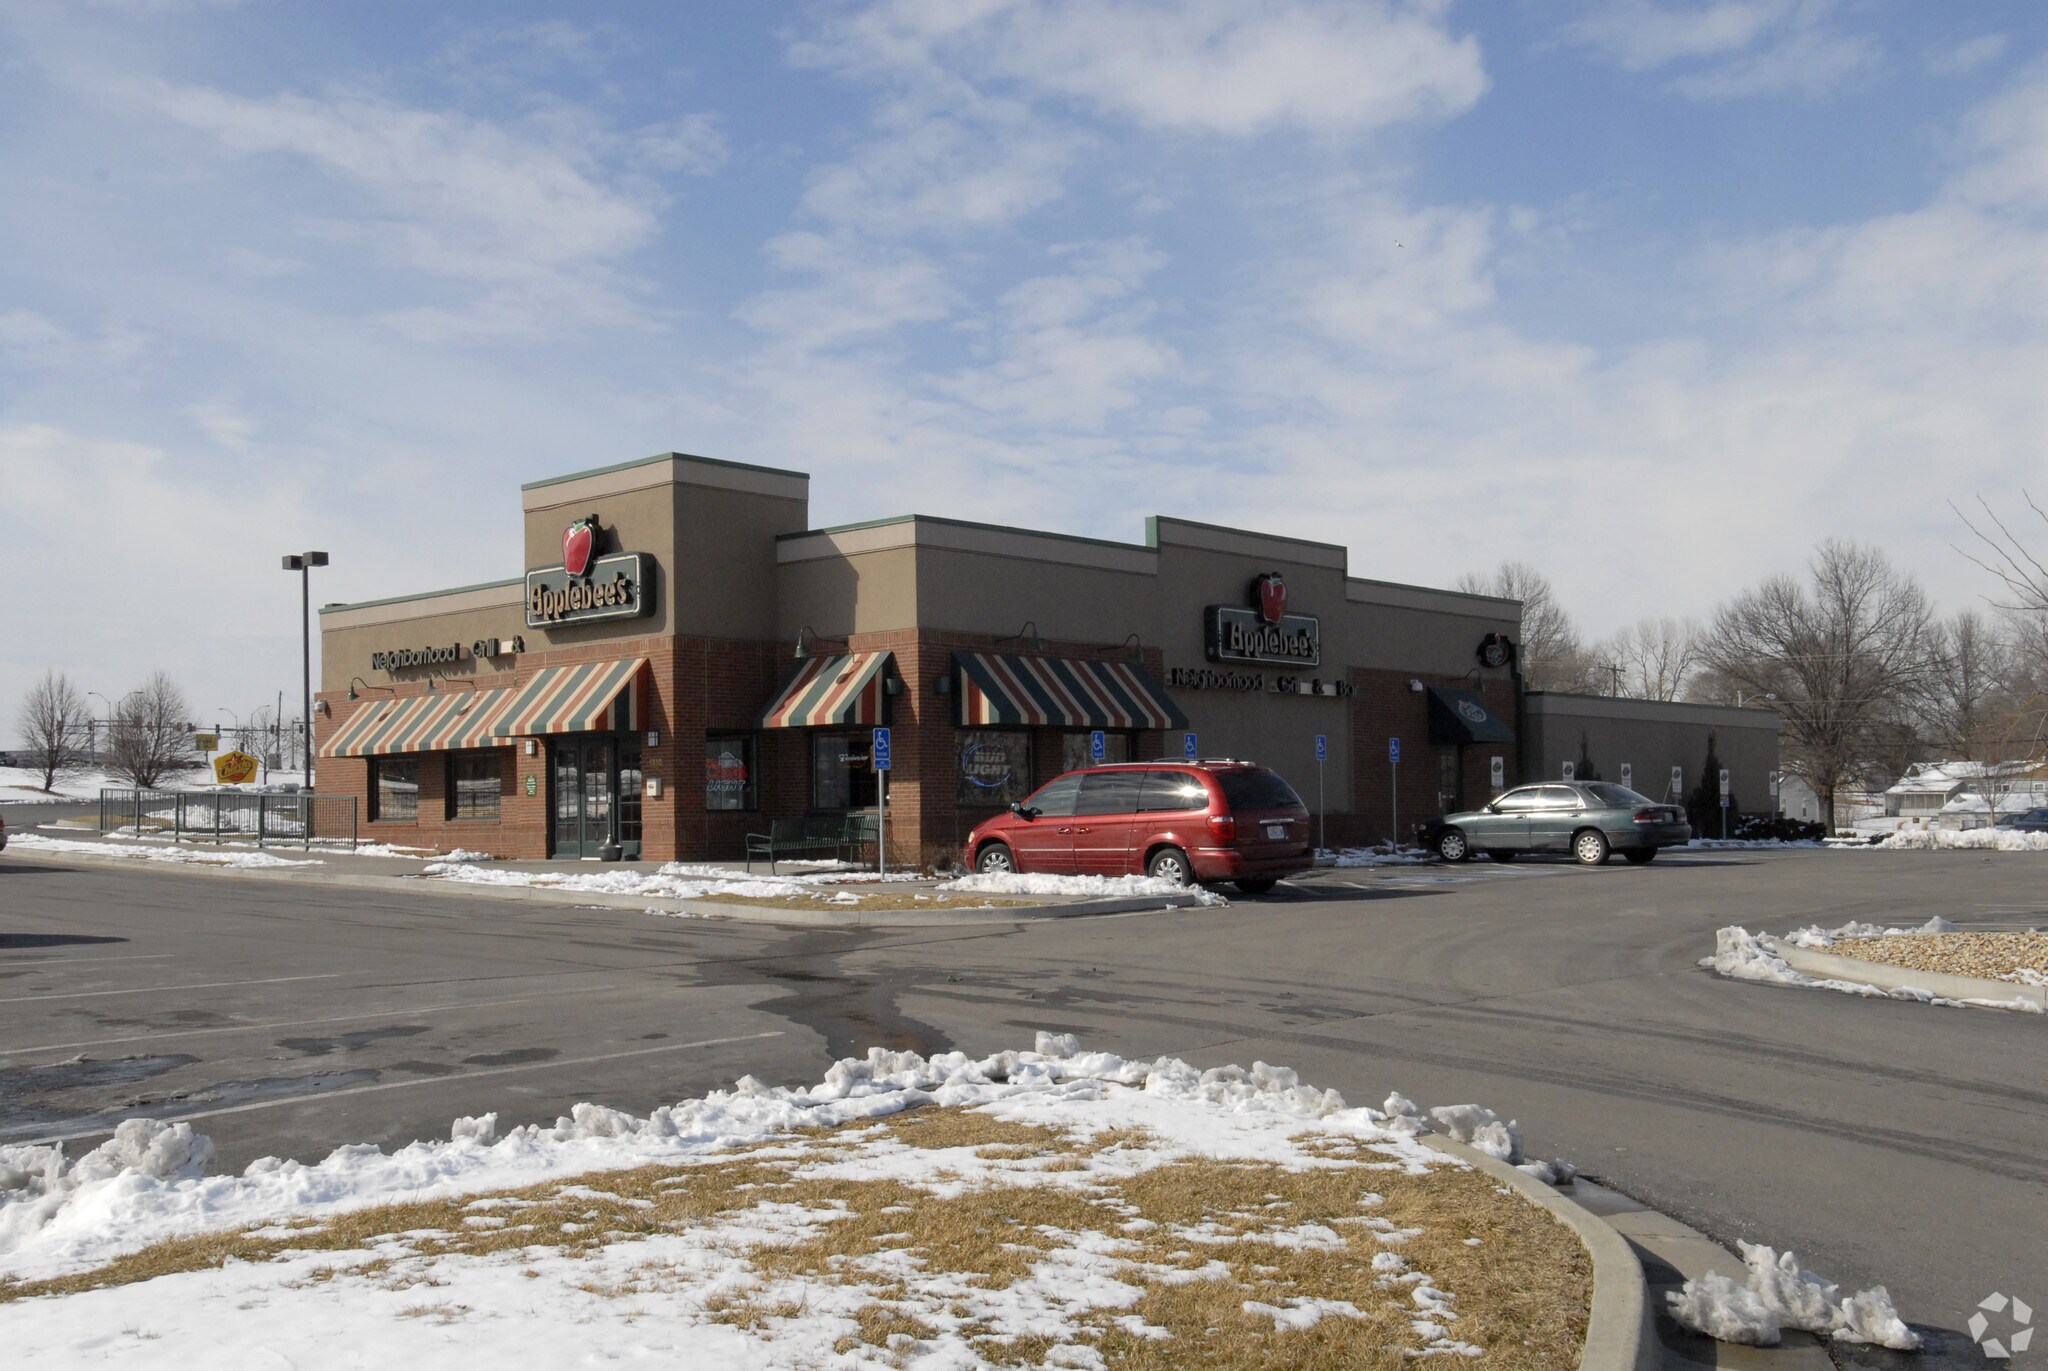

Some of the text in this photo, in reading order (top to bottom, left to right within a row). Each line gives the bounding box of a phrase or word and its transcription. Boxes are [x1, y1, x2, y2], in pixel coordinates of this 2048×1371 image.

[530, 571, 628, 620] Applebee's
[1229, 621, 1317, 657] Applebee's
[373, 641, 460, 671] Neighborhood
[473, 638, 499, 658] Grill
[1174, 668, 1264, 690] Neighborhood
[974, 751, 1006, 763] BUD
[965, 763, 1011, 775] LIGHT
[706, 779, 746, 792] LIGHT
